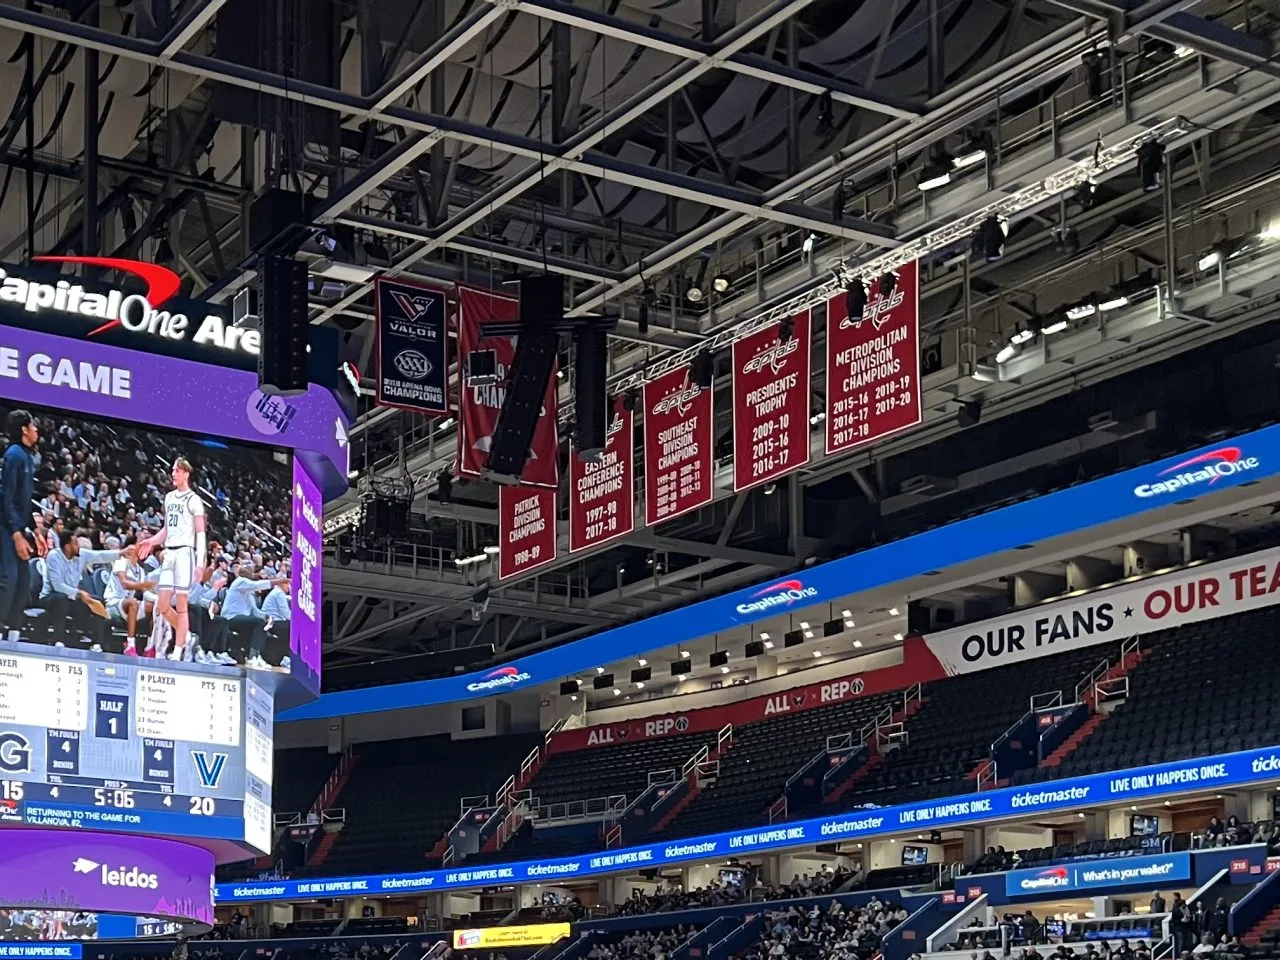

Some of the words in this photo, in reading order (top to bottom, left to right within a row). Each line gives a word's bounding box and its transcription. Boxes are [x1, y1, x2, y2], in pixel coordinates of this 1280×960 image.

[193, 316, 261, 355] Are
[389, 322, 437, 338] VALOR
[835, 325, 908, 367] METROPOLITAN
[850, 346, 893, 377] DIVISION
[27, 354, 131, 398] GAME
[842, 358, 901, 393] CHAMPIONS
[875, 375, 910, 400] 2018-19
[383, 385, 443, 403] CHAMPIONS
[755, 392, 787, 419] TROPHY
[833, 392, 869, 415] 2015-16
[875, 392, 911, 416] 2019-20
[658, 416, 698, 445] SOUTHEAST
[752, 413, 790, 442] 2009-10
[833, 407, 869, 431] 2016-17
[663, 432, 693, 456] DIVISION
[752, 432, 789, 460] 2015-16
[833, 423, 869, 446] 2017-18
[658, 443, 699, 470] CHAMPIONS
[752, 450, 789, 477] 2016-17
[577, 460, 625, 491] CONFERENCE
[1134, 457, 1260, 498] CapitalOne
[579, 476, 623, 504] CHAMPIONS
[514, 495, 539, 516] PATRICK
[514, 507, 541, 529] DIVISION
[586, 517, 617, 540] 2017-18
[509, 519, 545, 543] CHAMPIONS
[736, 583, 818, 615] CapitalOne
[961, 625, 1026, 662] OUR
[1035, 602, 1114, 647] FANS
[1144, 577, 1220, 620] OUR
[45, 663, 60, 673] PTS
[68, 666, 83, 675] FLS
[148, 675, 176, 685] PLAYER
[201, 681, 216, 690] PTS
[223, 684, 236, 692] FLS
[100, 700, 123, 712] HALF
[765, 694, 790, 715] ALL
[108, 717, 117, 734] 1
[587, 728, 614, 746] ALL
[62, 741, 71, 753] 4
[153, 749, 163, 761] 4
[191, 750, 228, 788] V
[1110, 777, 1130, 793] LIVE
[1132, 773, 1155, 789] ONLY
[1156, 769, 1198, 786] HAPPENS
[1200, 764, 1229, 780] ONCE.
[2, 781, 23, 800] 15
[50, 786, 59, 798] 4
[94, 788, 135, 808] 5:06
[163, 795, 172, 807] 4
[1012, 787, 1090, 807] ticketmaster
[27, 807, 71, 818] RETURNING
[73, 810, 84, 819] TO
[85, 812, 100, 820] THE
[101, 813, 123, 822] GAME
[124, 814, 141, 823] FOR
[189, 796, 215, 815] 20
[101, 864, 158, 889] leidos
[1121, 868, 1140, 880] your
